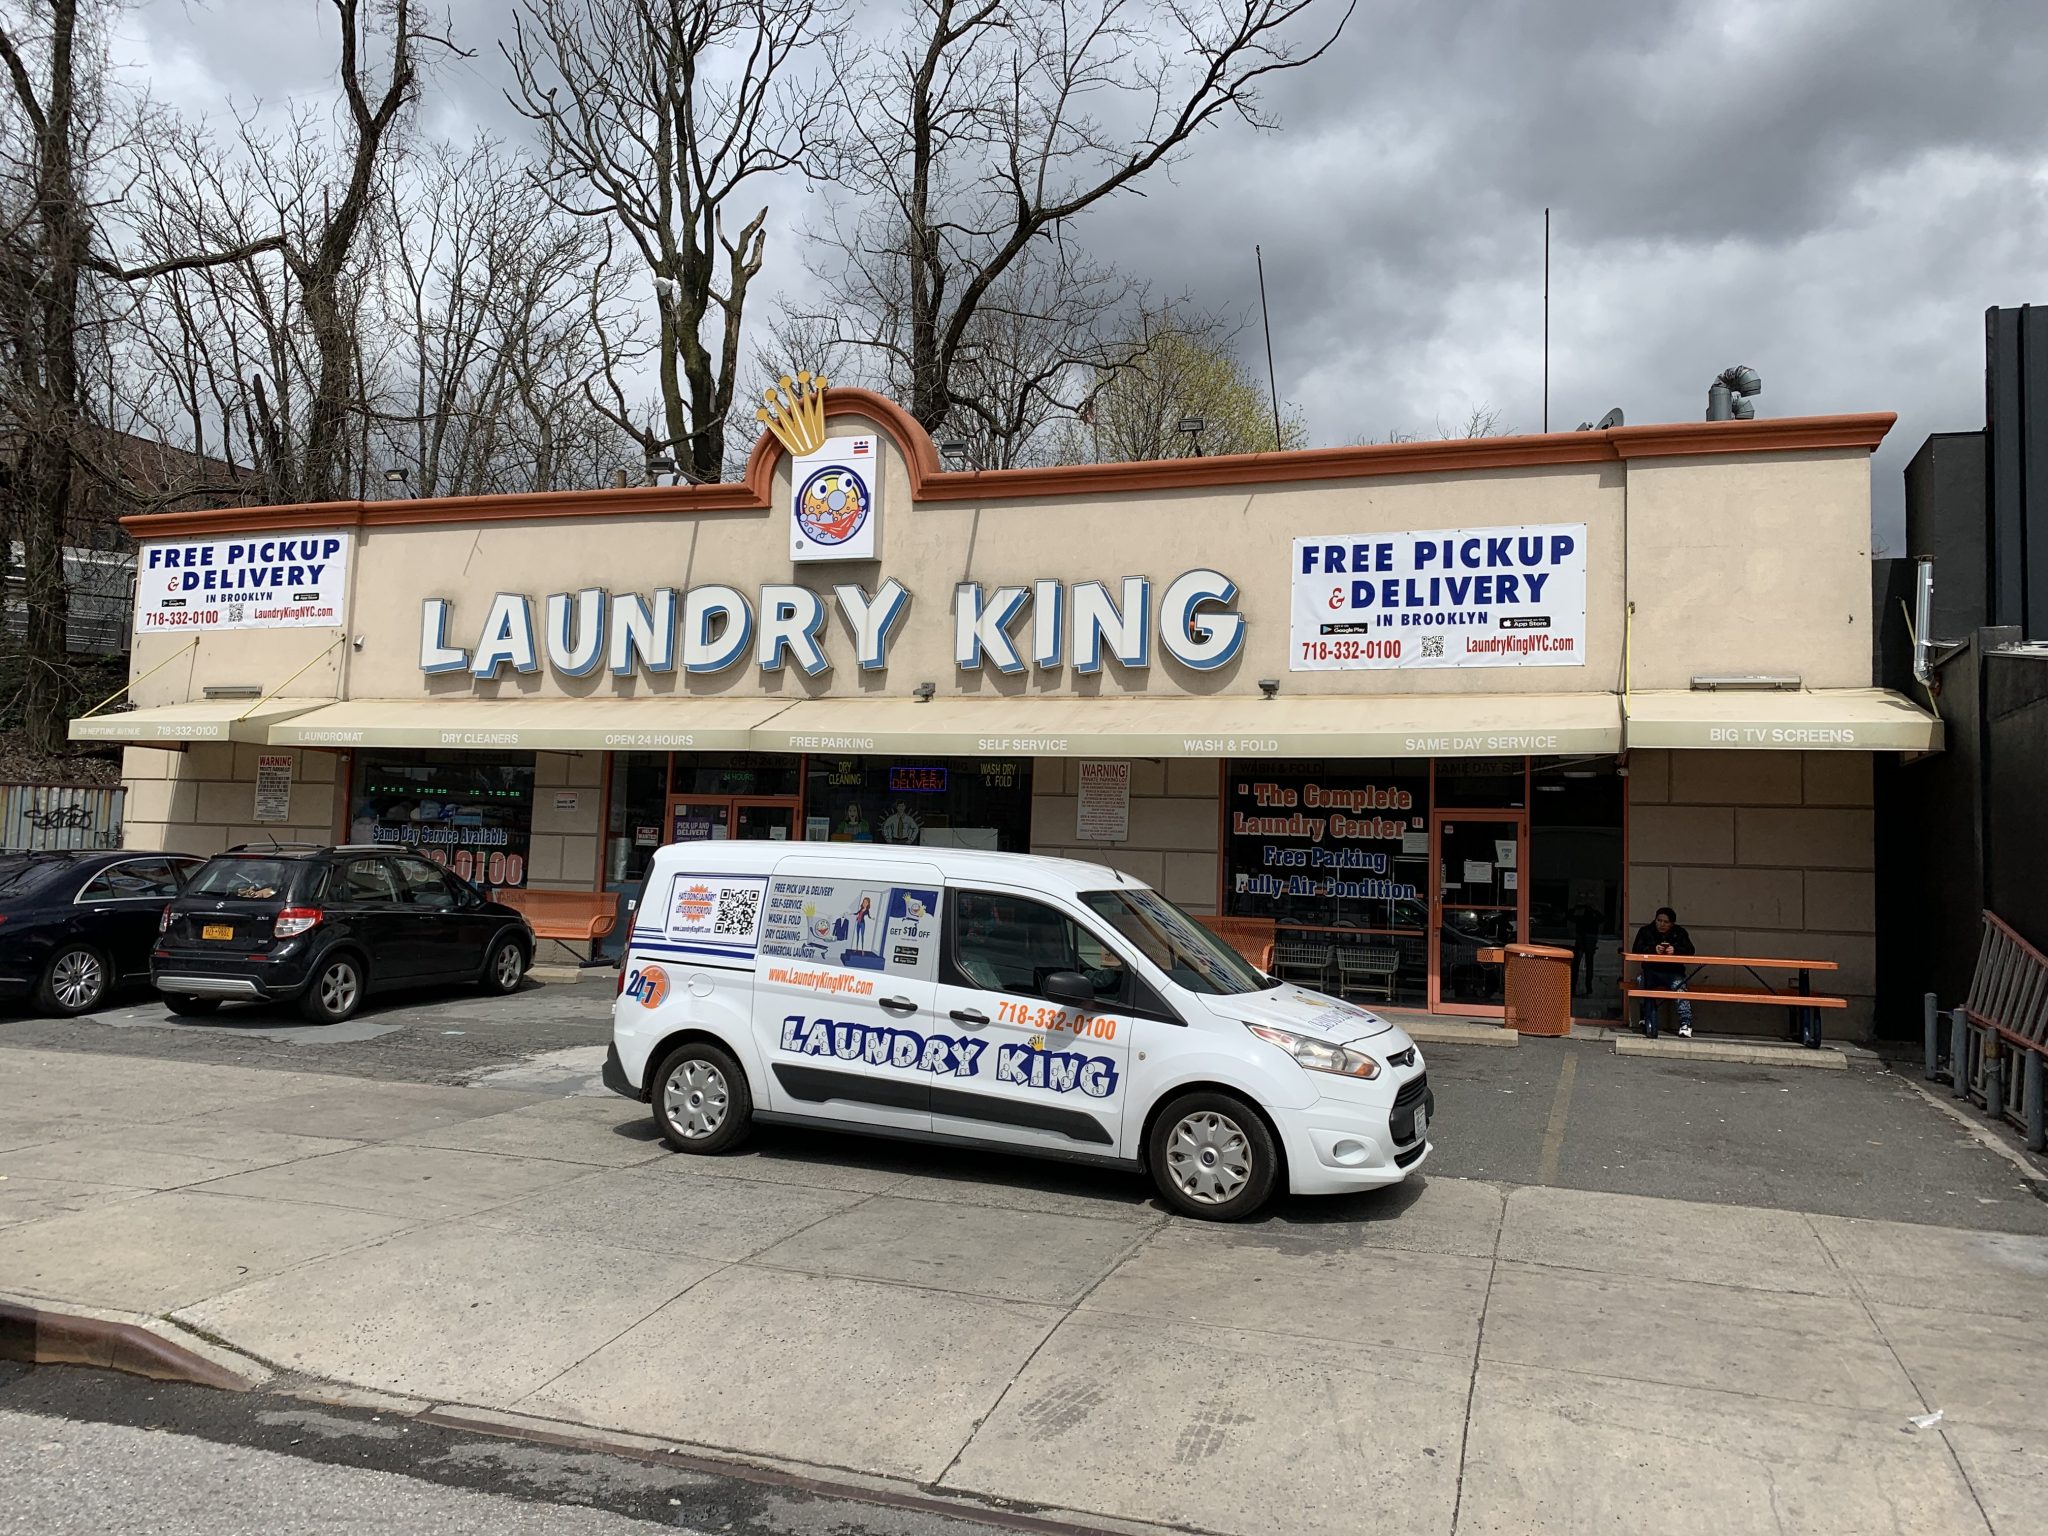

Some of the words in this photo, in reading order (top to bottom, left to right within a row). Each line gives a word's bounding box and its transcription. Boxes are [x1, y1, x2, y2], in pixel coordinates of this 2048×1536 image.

[149, 547, 214, 569] FREE
[228, 539, 341, 564] PICKUP
[1302, 543, 1393, 575] FREE
[1415, 535, 1575, 570] PICKUP
[167, 576, 180, 592] &
[182, 564, 325, 591] DELIVERY
[206, 594, 216, 603] IN
[220, 591, 273, 603] BROOKLYN
[1328, 587, 1345, 610] &
[1351, 573, 1550, 609] DELIVERY
[146, 610, 218, 626] 718-332-0100
[254, 606, 333, 621] LaundryKingNYC.com
[1376, 614, 1393, 627] IN
[1401, 611, 1488, 626] BROOKLYN
[418, 576, 911, 679] LAUNDRY
[954, 568, 1247, 675] KING
[1302, 639, 1401, 661] 718-332-0100
[1466, 634, 1574, 656] LaundryKingNYC.com
[88, 727, 115, 735] NEPTUNE
[117, 727, 141, 735] AVENUE
[157, 726, 218, 736] 718-332-0100
[298, 731, 364, 742] LAUNDROMAT
[441, 733, 462, 744] DRY
[464, 733, 519, 744] CLEANERS
[1710, 728, 1739, 742] BIG
[1744, 728, 1767, 742] TV
[1772, 728, 1854, 743] SCREENS
[605, 734, 635, 745] OPEN
[638, 735, 652, 745] 24
[654, 735, 694, 745] HOURS
[789, 736, 819, 747] FREE
[821, 737, 873, 749] PARKING
[978, 739, 1010, 750] SELF
[1013, 739, 1068, 751] SERVICE
[1183, 740, 1224, 751] WASH
[1227, 740, 1237, 751] &
[1240, 740, 1278, 752] FOLD
[1405, 738, 1449, 751] SAME
[1453, 737, 1483, 750] DAY
[1487, 736, 1557, 749] SERVICE
[259, 756, 292, 767] WARNING
[838, 761, 852, 774] DRY
[980, 763, 1000, 775] WASH
[1002, 763, 1016, 775] DRY
[899, 769, 937, 779] FREE
[1081, 763, 1129, 778] WARNING!
[828, 773, 861, 786] CLEANING
[892, 779, 944, 789] DELIVERY
[985, 775, 991, 787] &
[994, 775, 1012, 787] FOLD
[1254, 783, 1298, 807] The
[1303, 783, 1412, 814] Complete
[677, 821, 690, 830] PICK
[1233, 811, 1326, 843] Laundry
[1329, 814, 1407, 840] Center
[373, 824, 400, 842] Same
[401, 825, 420, 846] Day
[422, 825, 458, 844] Service
[460, 826, 508, 846] Available
[1263, 845, 1306, 866] Free
[1311, 847, 1387, 874] Parking
[774, 882, 785, 893] FREE
[785, 883, 797, 894] PICK
[798, 884, 805, 894] UP
[805, 885, 810, 895] &
[811, 885, 834, 897] DELIVERY
[1236, 873, 1283, 899] Fully
[1288, 875, 1317, 896] Air
[1324, 876, 1416, 900] Condition
[770, 897, 803, 910] SELF-SERVICE
[768, 913, 782, 924] WASH
[783, 914, 788, 924] &
[788, 915, 801, 925] FOLD
[764, 928, 776, 939] DRY
[777, 929, 801, 941] CLEANING
[890, 927, 902, 935] GET
[902, 926, 918, 937] $10
[918, 930, 930, 938] OFF
[762, 943, 792, 958] COMMERCIAL
[793, 947, 816, 959] LAUNDRY
[768, 966, 874, 995] www.LaundryKingNYC.com
[997, 1001, 1116, 1042] 718-332-0100
[780, 1015, 989, 1077] LAUNDRY
[996, 1043, 1119, 1099] KING
